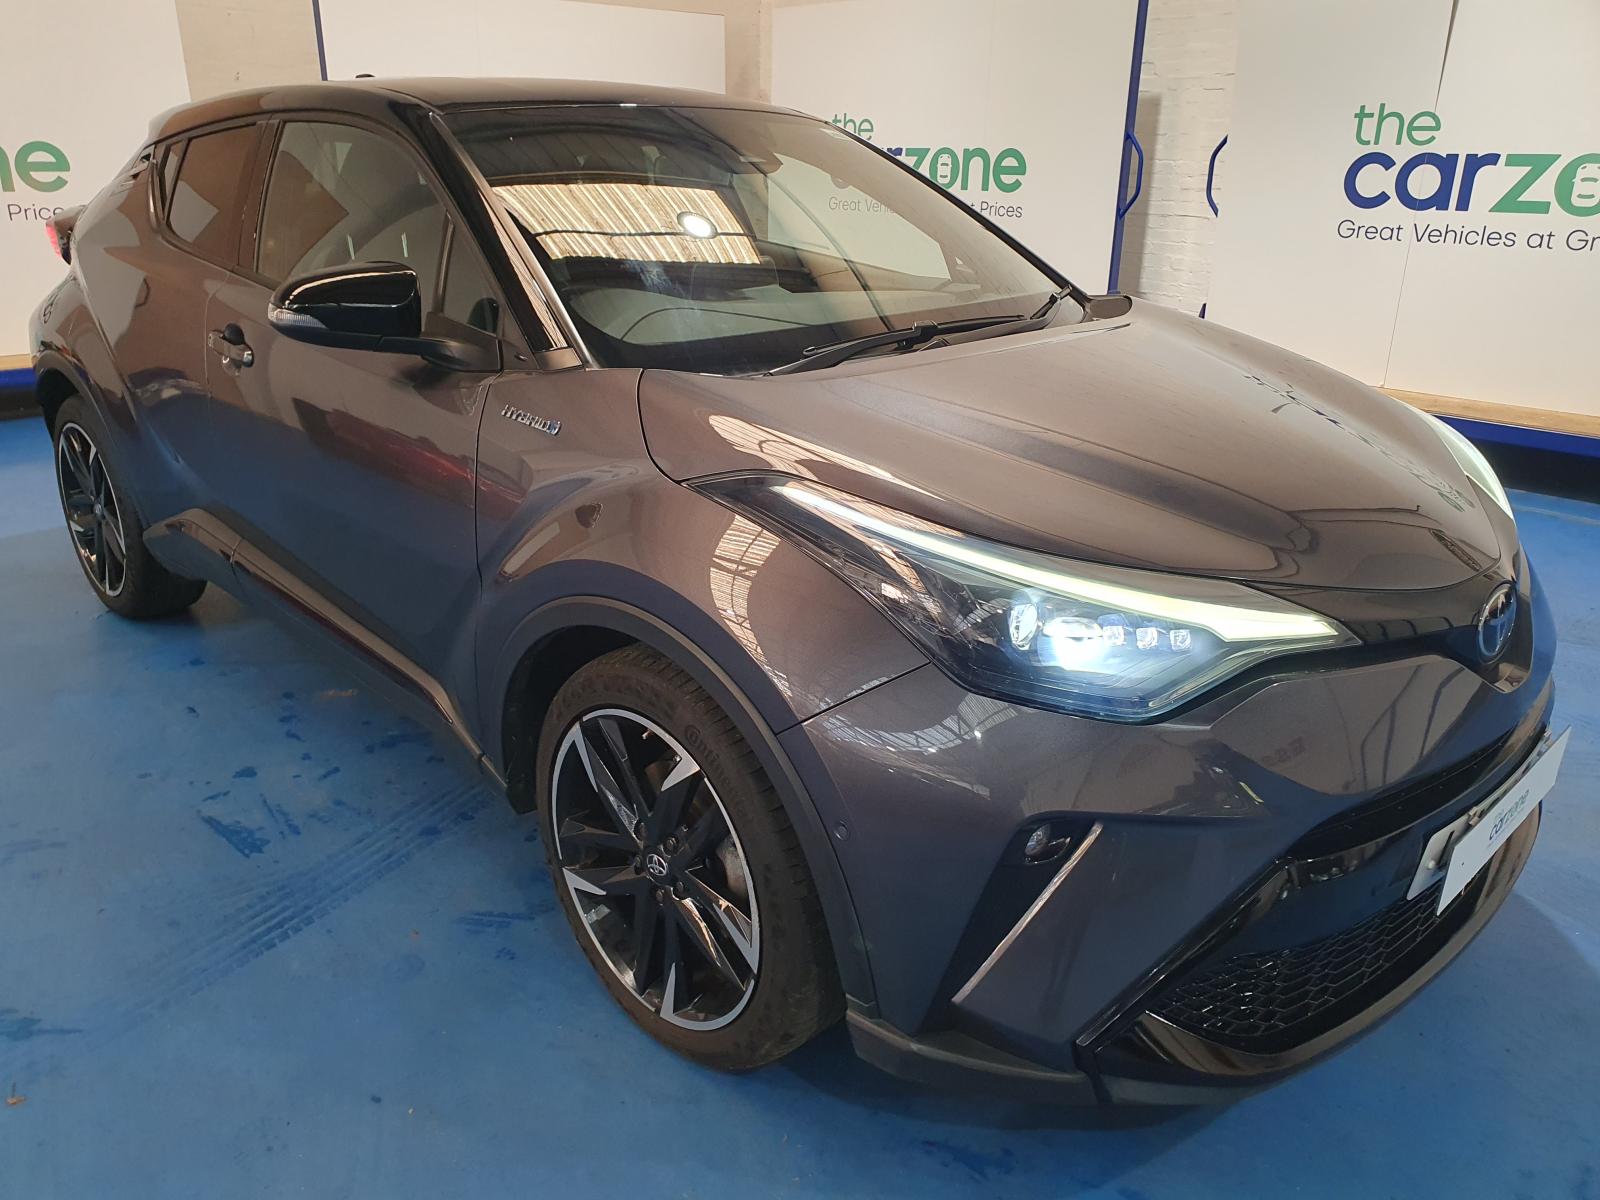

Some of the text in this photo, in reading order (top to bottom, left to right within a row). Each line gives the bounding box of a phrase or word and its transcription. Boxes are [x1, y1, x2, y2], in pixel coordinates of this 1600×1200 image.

[1354, 103, 1441, 145] the
[828, 196, 861, 211] Great
[980, 201, 1023, 218] Prices
[1337, 219, 1403, 242] Great
[1413, 223, 1516, 248] Vehicles
[1526, 231, 1555, 250] at
[501, 404, 560, 435] HYBRID
